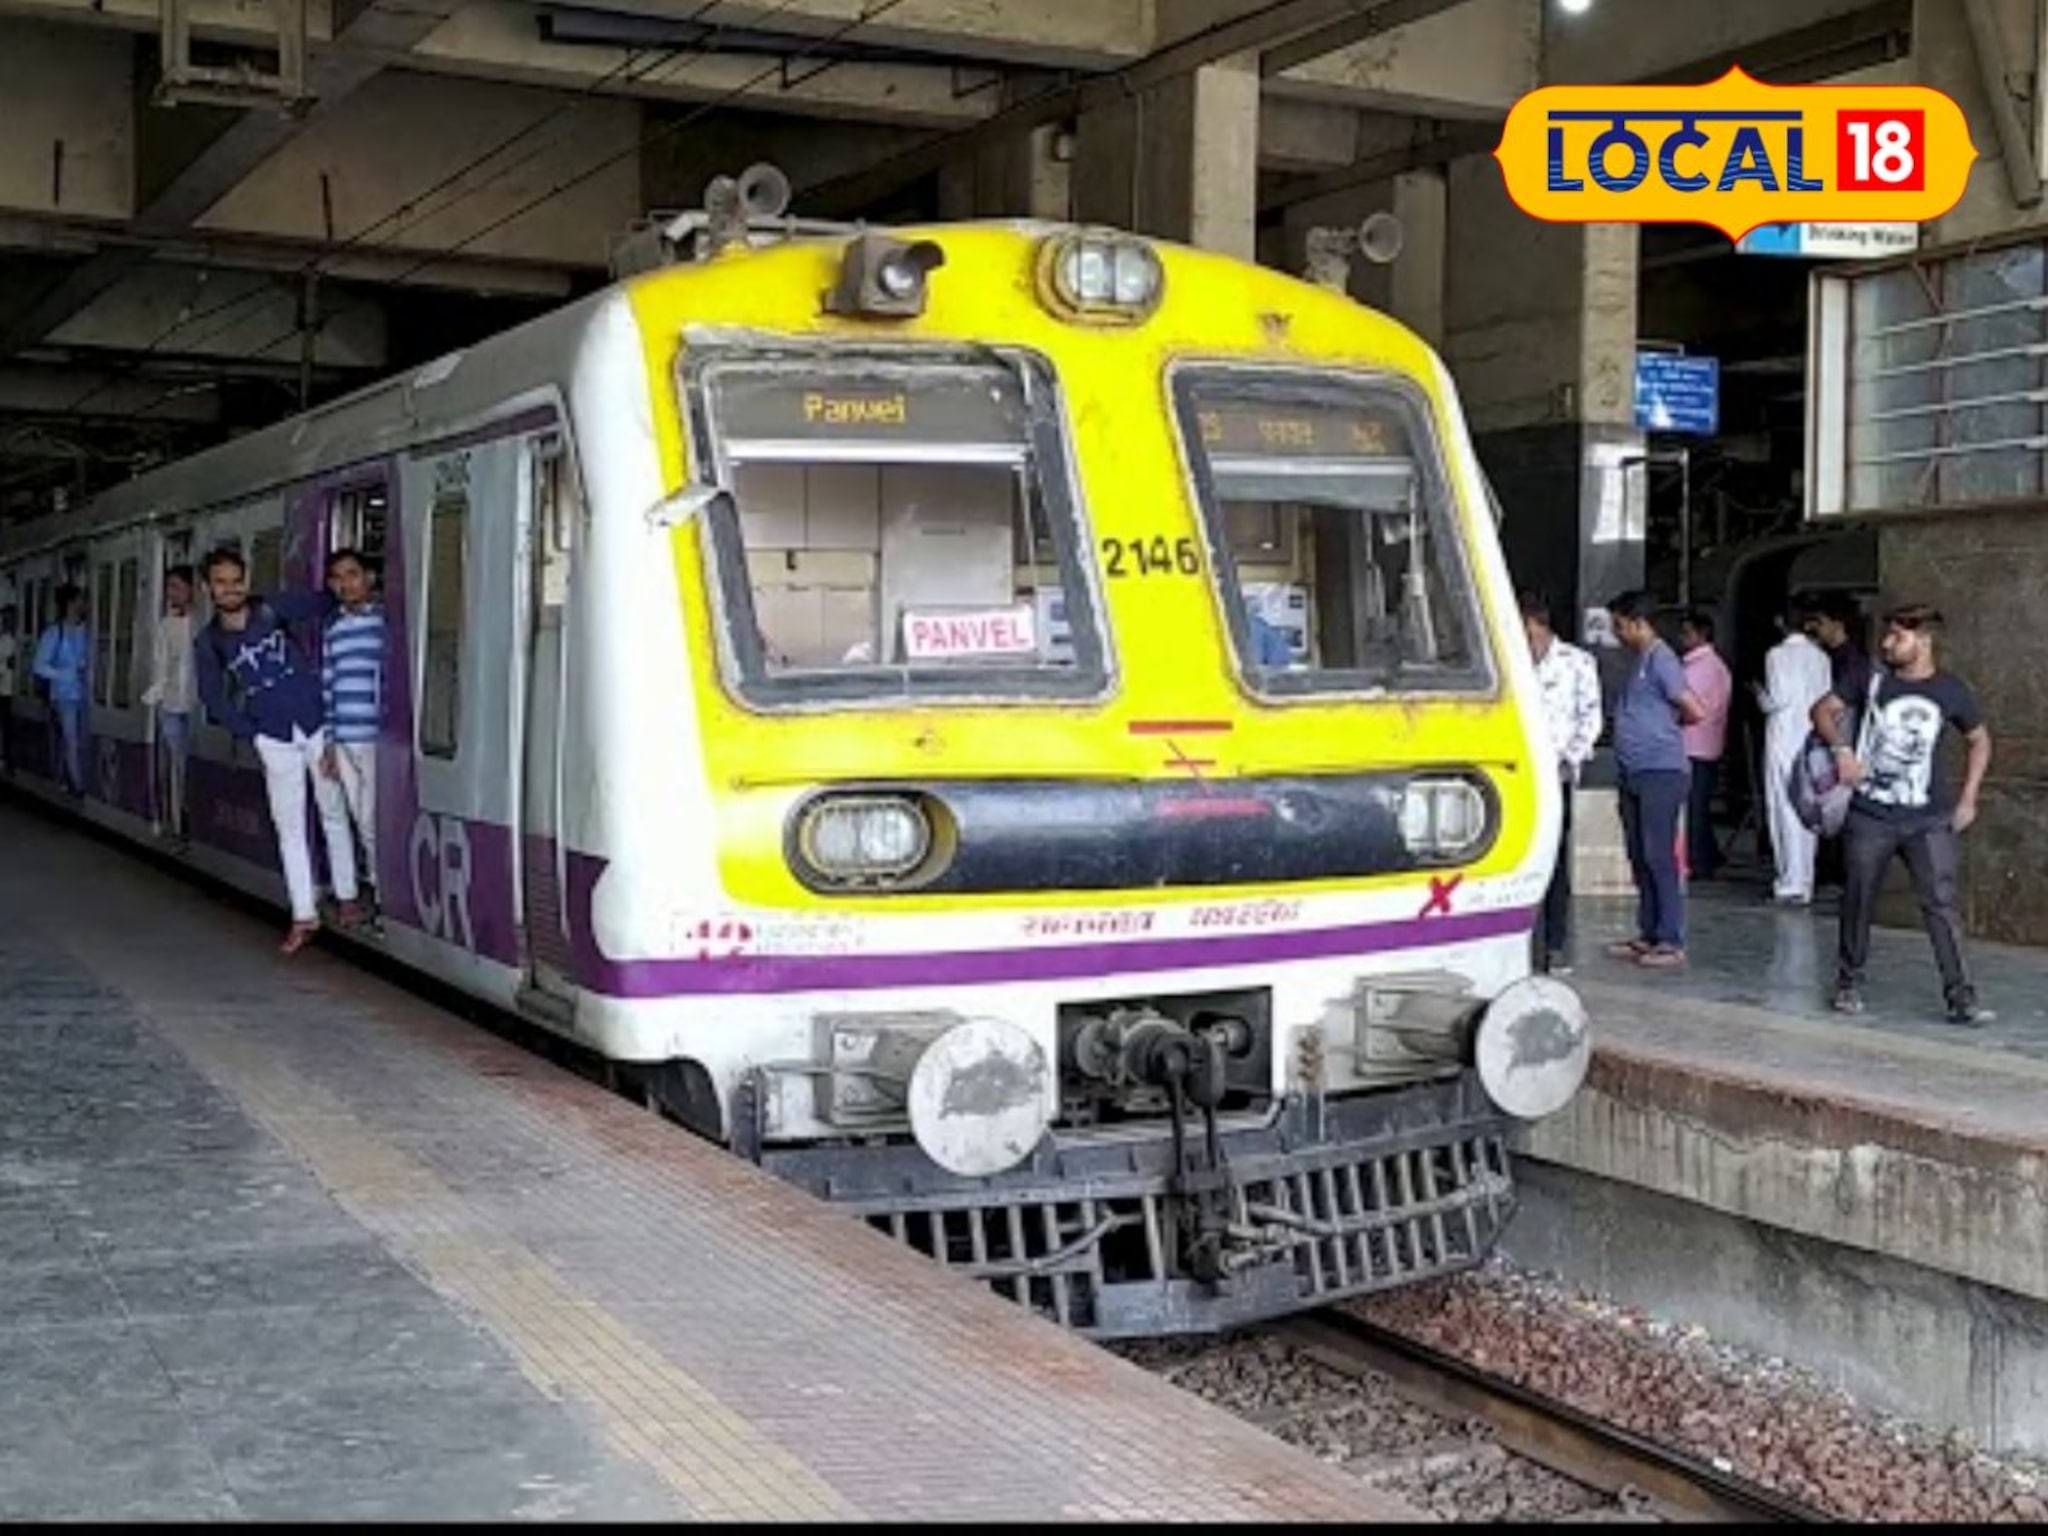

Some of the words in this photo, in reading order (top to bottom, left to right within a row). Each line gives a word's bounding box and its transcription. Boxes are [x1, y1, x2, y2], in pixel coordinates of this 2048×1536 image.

[1102, 534, 1199, 576] 2146
[912, 617, 1030, 651] PANVEL
[410, 811, 476, 948] CR
